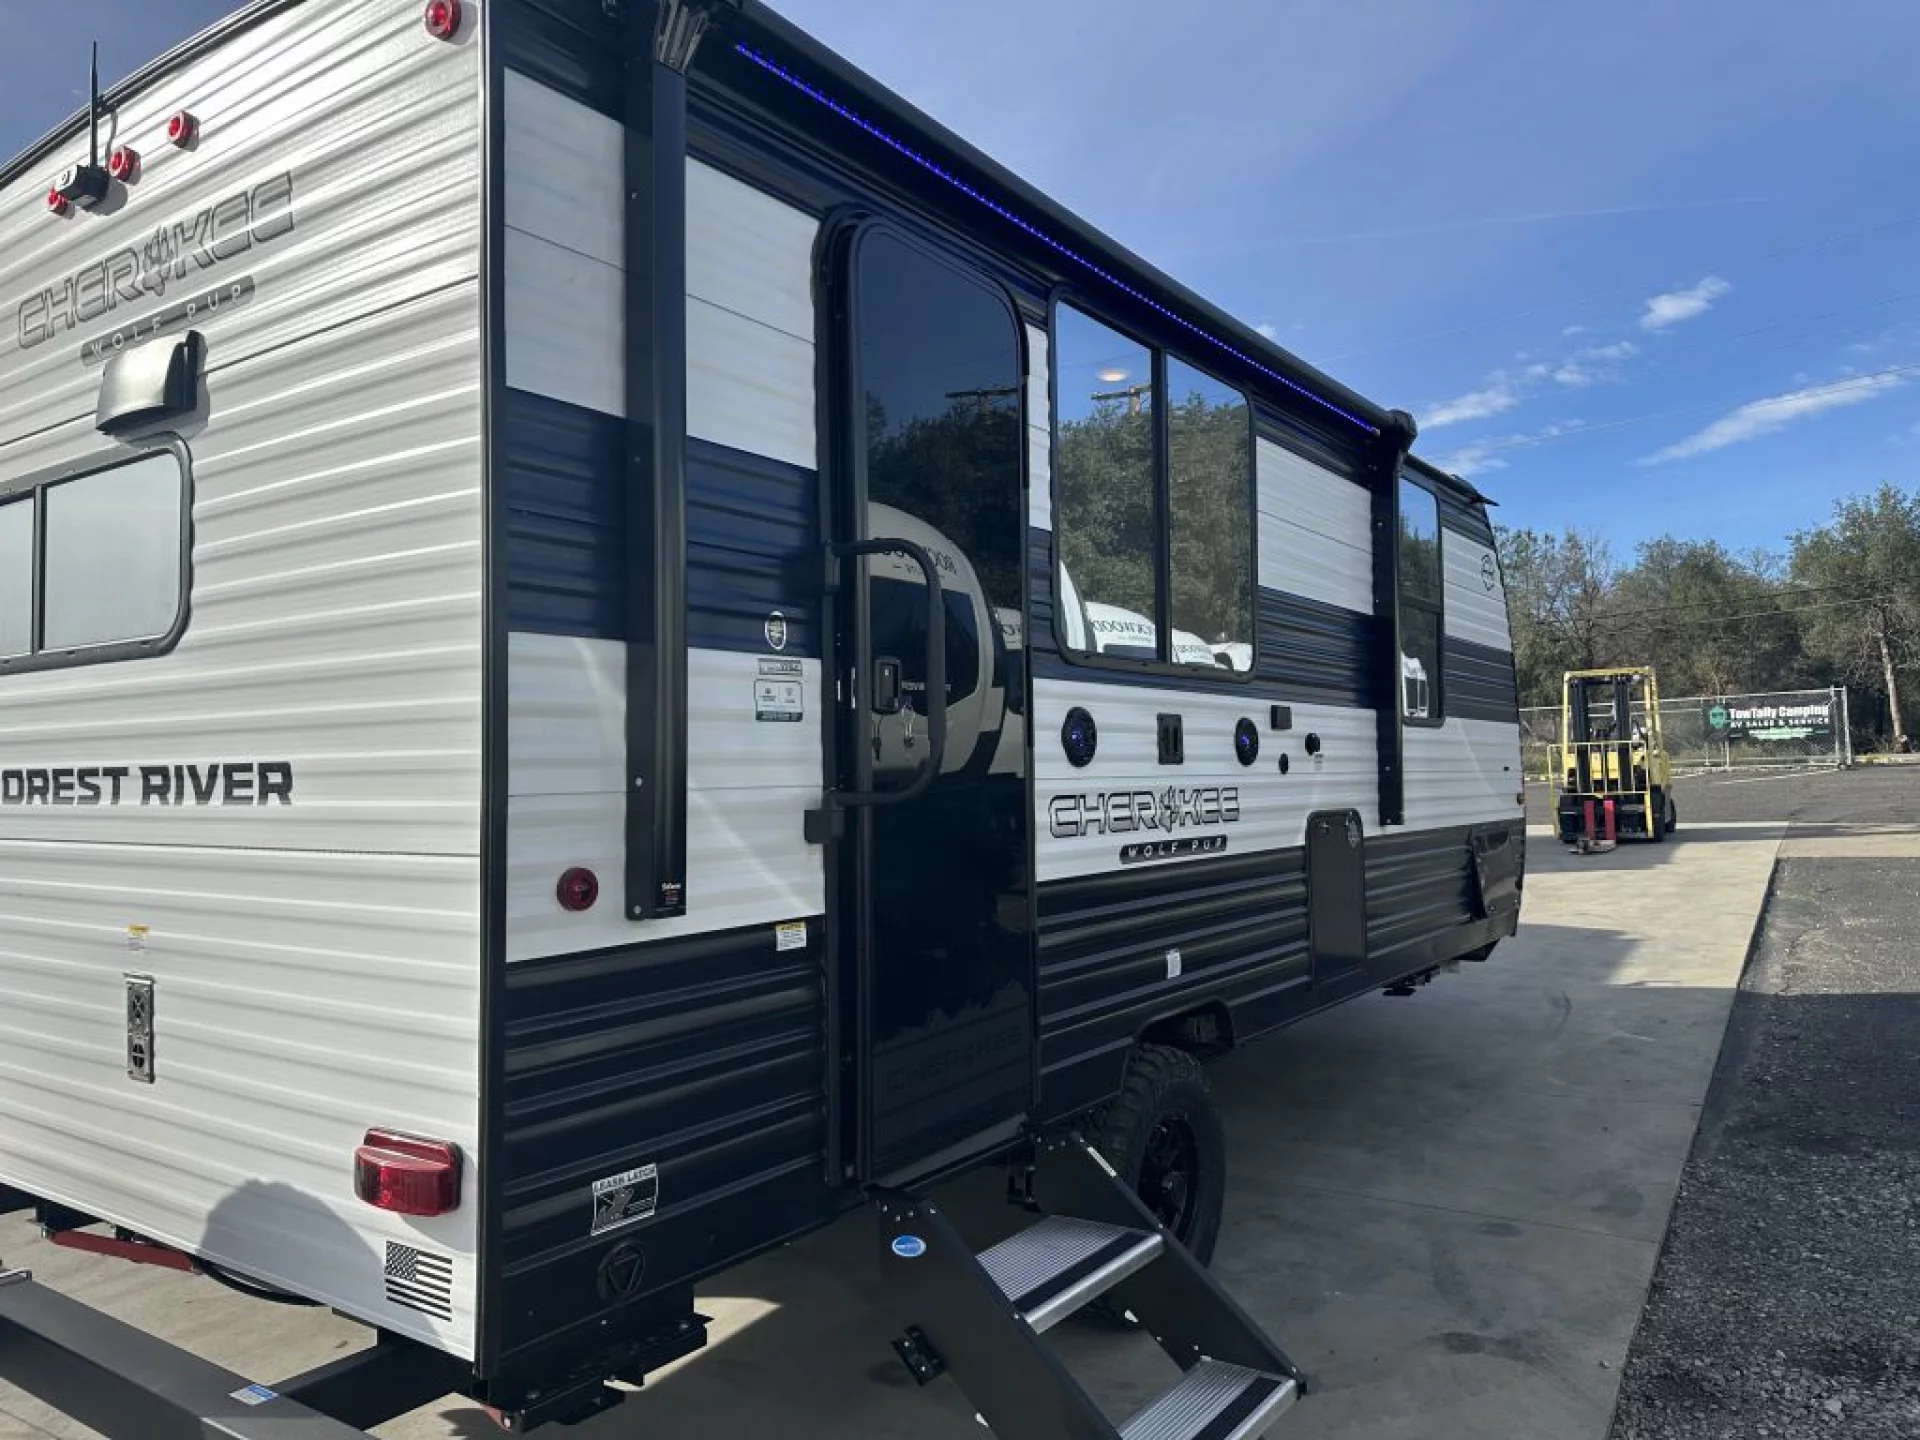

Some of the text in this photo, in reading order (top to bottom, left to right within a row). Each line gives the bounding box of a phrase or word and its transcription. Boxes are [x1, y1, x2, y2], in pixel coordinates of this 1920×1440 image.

[91, 283, 241, 360] WOLF PUP
[1778, 704, 1829, 718] Camping
[139, 760, 293, 806] RIVER
[1128, 837, 1222, 858] WOLF PUP
